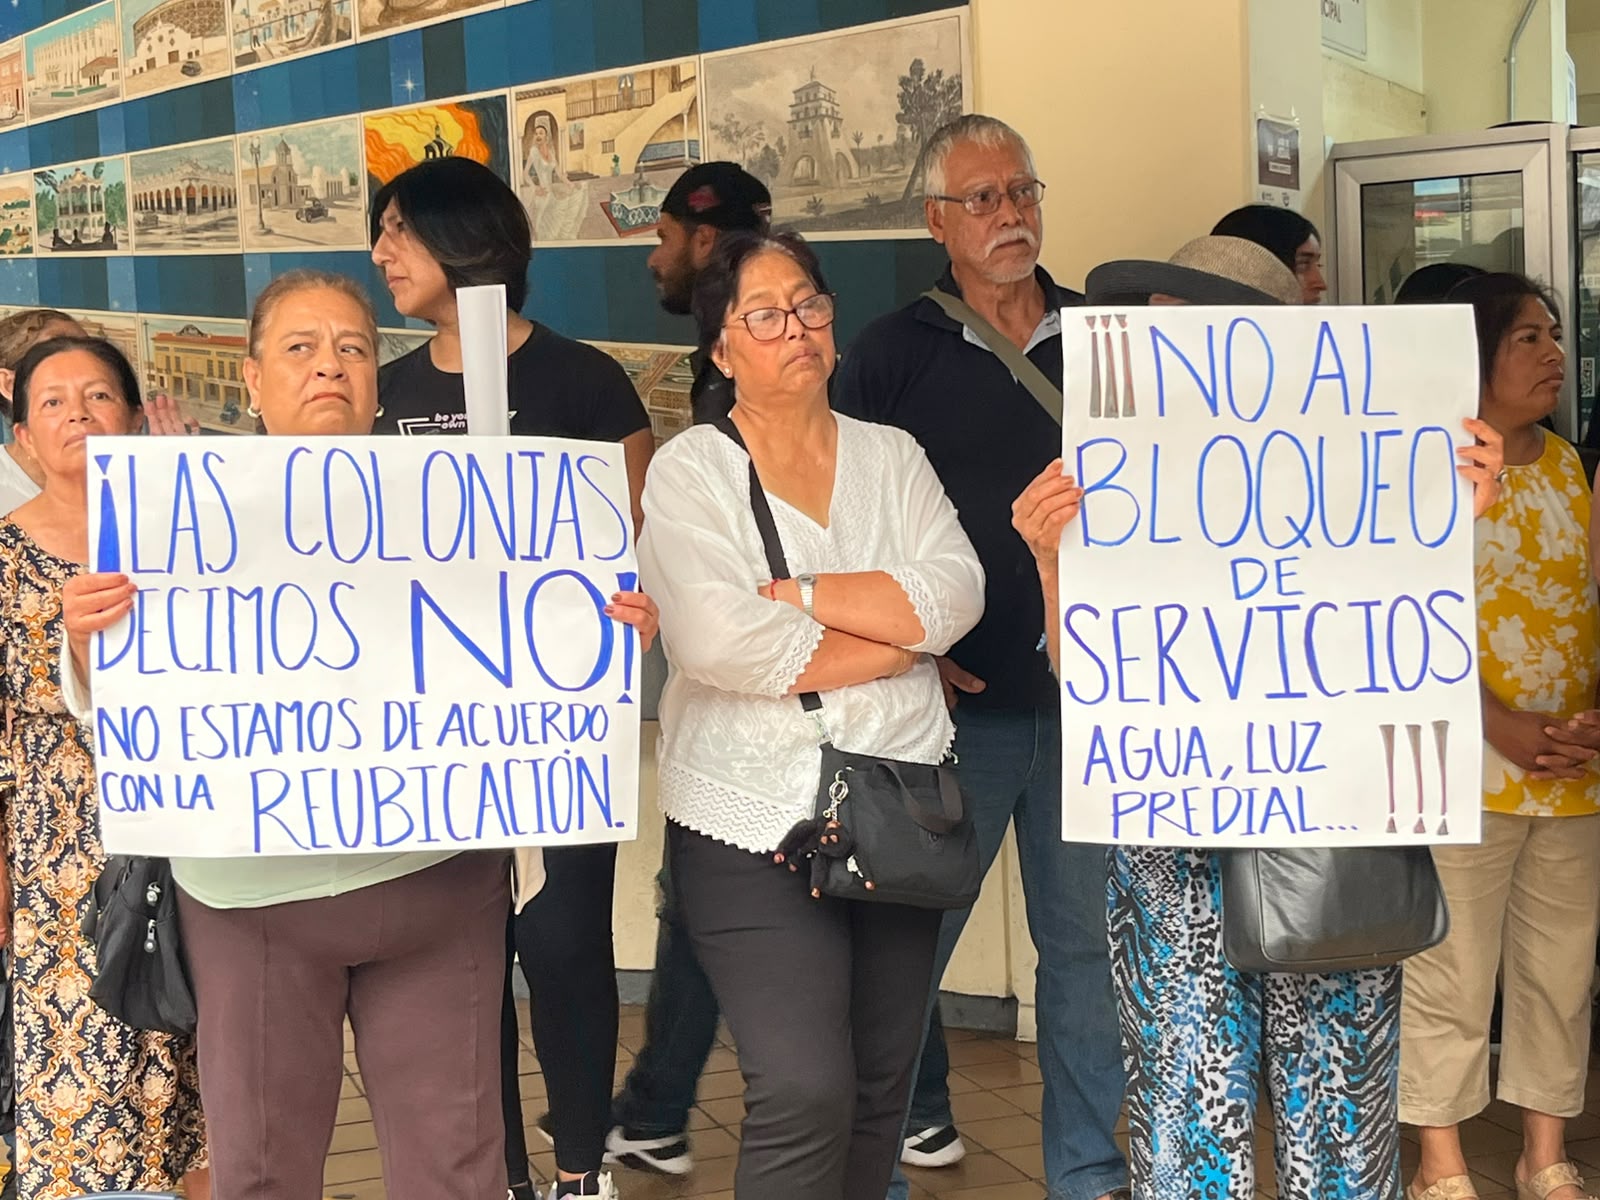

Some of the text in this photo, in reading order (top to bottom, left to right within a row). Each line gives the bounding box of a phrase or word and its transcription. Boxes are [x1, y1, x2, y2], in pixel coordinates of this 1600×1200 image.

[1301, 321, 1398, 415] AL
[441, 420, 466, 429] own
[94, 448, 628, 574] ¡LAS COLONIAS
[1077, 426, 1458, 549] BLOQUEO
[1231, 557, 1305, 601] DE
[410, 570, 638, 704] NO!
[1064, 590, 1472, 705] SERVICIOS
[97, 698, 609, 761] NO ESTAMOS DE ACUERDO
[1083, 721, 1327, 785] AGUA, LUZ
[102, 749, 625, 853] CON LA REUBICACIÓN.
[1112, 786, 1358, 839] PREDIAL...
